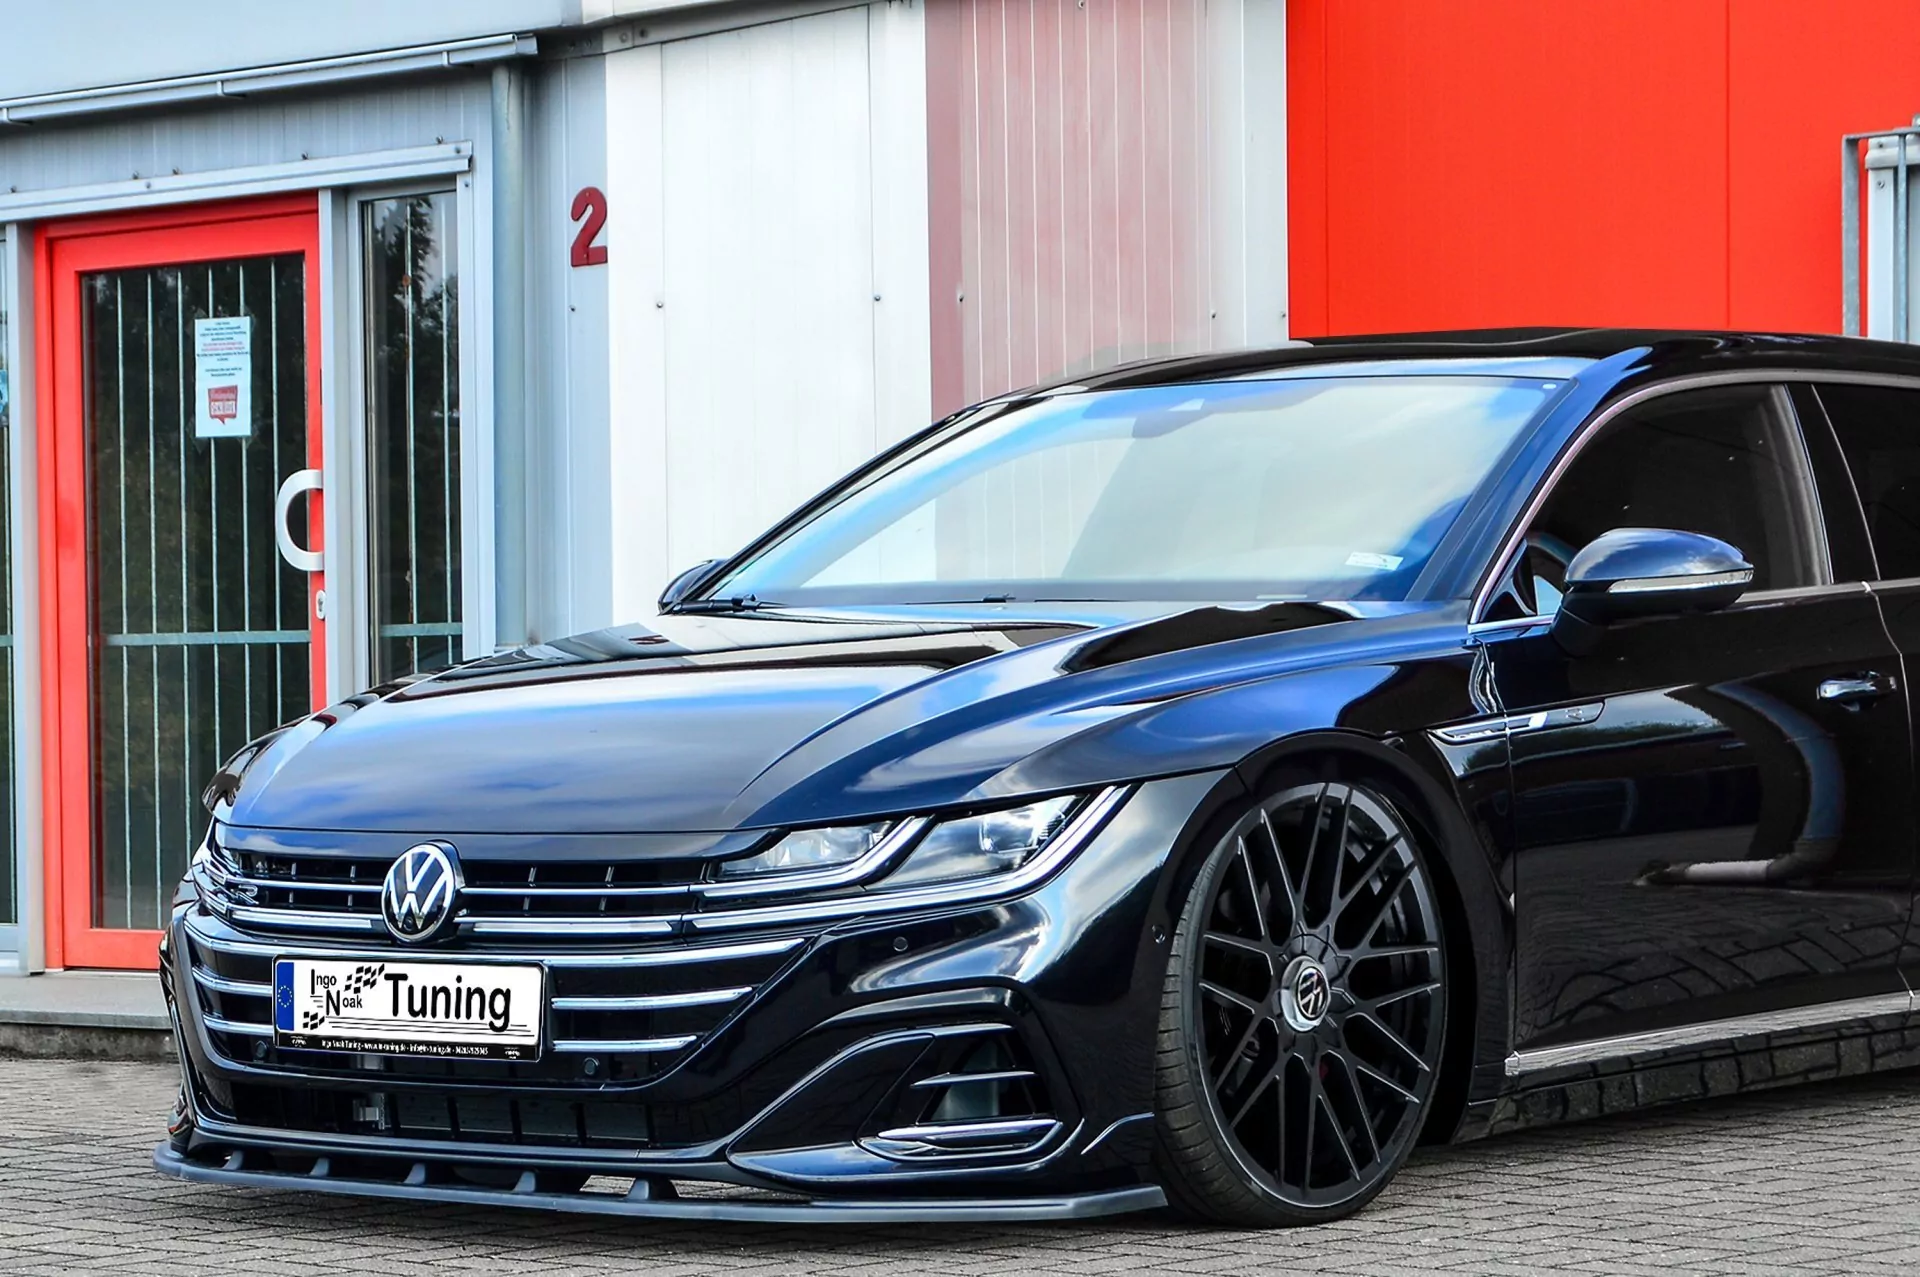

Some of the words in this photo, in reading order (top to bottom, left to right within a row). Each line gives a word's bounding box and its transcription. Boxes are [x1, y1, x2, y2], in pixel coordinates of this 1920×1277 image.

[571, 187, 608, 268] 2
[383, 846, 454, 939] VW
[310, 968, 337, 995] Ingo
[325, 989, 363, 1017] Noak
[384, 973, 511, 1033] Tuning
